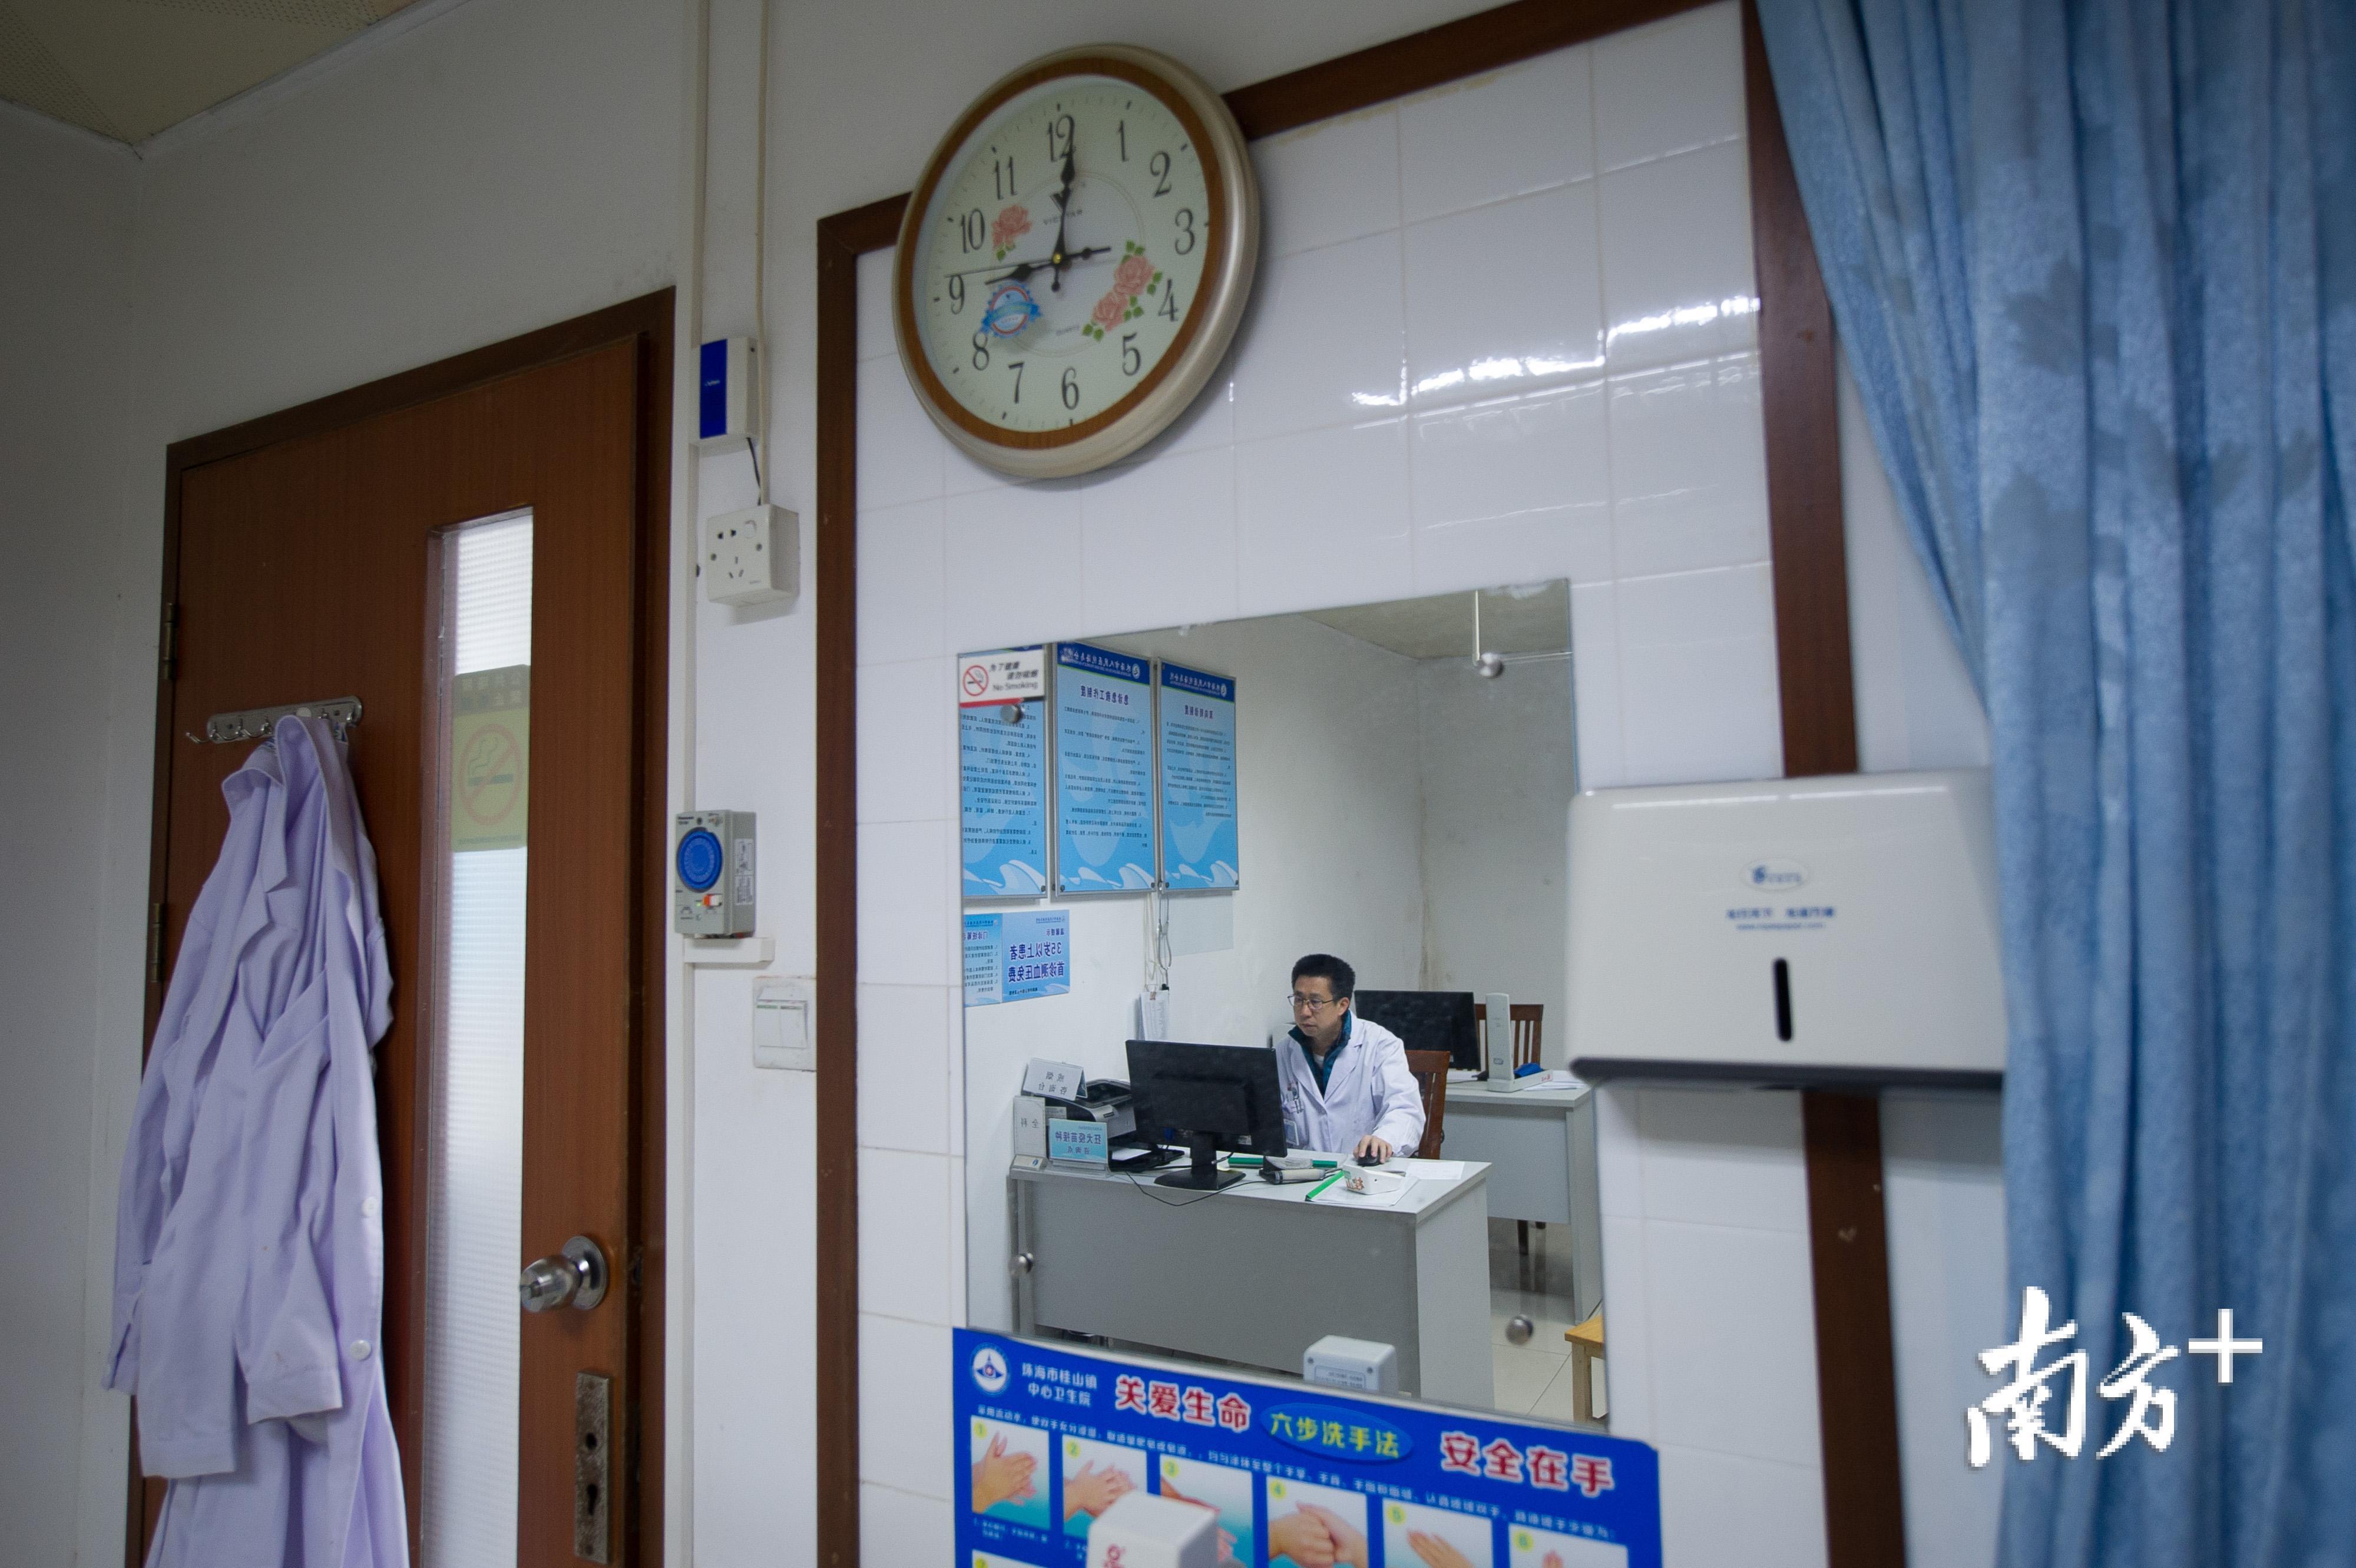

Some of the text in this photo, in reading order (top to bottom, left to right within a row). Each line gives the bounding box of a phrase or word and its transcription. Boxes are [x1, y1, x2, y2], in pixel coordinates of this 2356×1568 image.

[1117, 120, 1130, 163] 1
[994, 156, 1018, 200] 11
[1150, 151, 1172, 198] 2
[959, 209, 985, 254] 10
[1174, 208, 1195, 255] 3
[948, 274, 965, 315] 9
[1157, 279, 1179, 322] 4
[972, 328, 990, 371] 8
[1121, 334, 1141, 377] 5
[1008, 362, 1025, 404] 7
[1061, 367, 1080, 411] 6
[990, 661, 1020, 672] 为了健康
[1005, 682, 1038, 691] Smoking
[1007, 669, 1038, 680] 请勿吸烟
[1021, 1362, 1098, 1390] 珠海市桂山镇
[1028, 1382, 1091, 1408] 中心卫生院
[1115, 1374, 1252, 1433] 关爱生命
[1270, 1411, 1400, 1459] 六步洗手法
[1440, 1430, 1615, 1498] 安全在手
